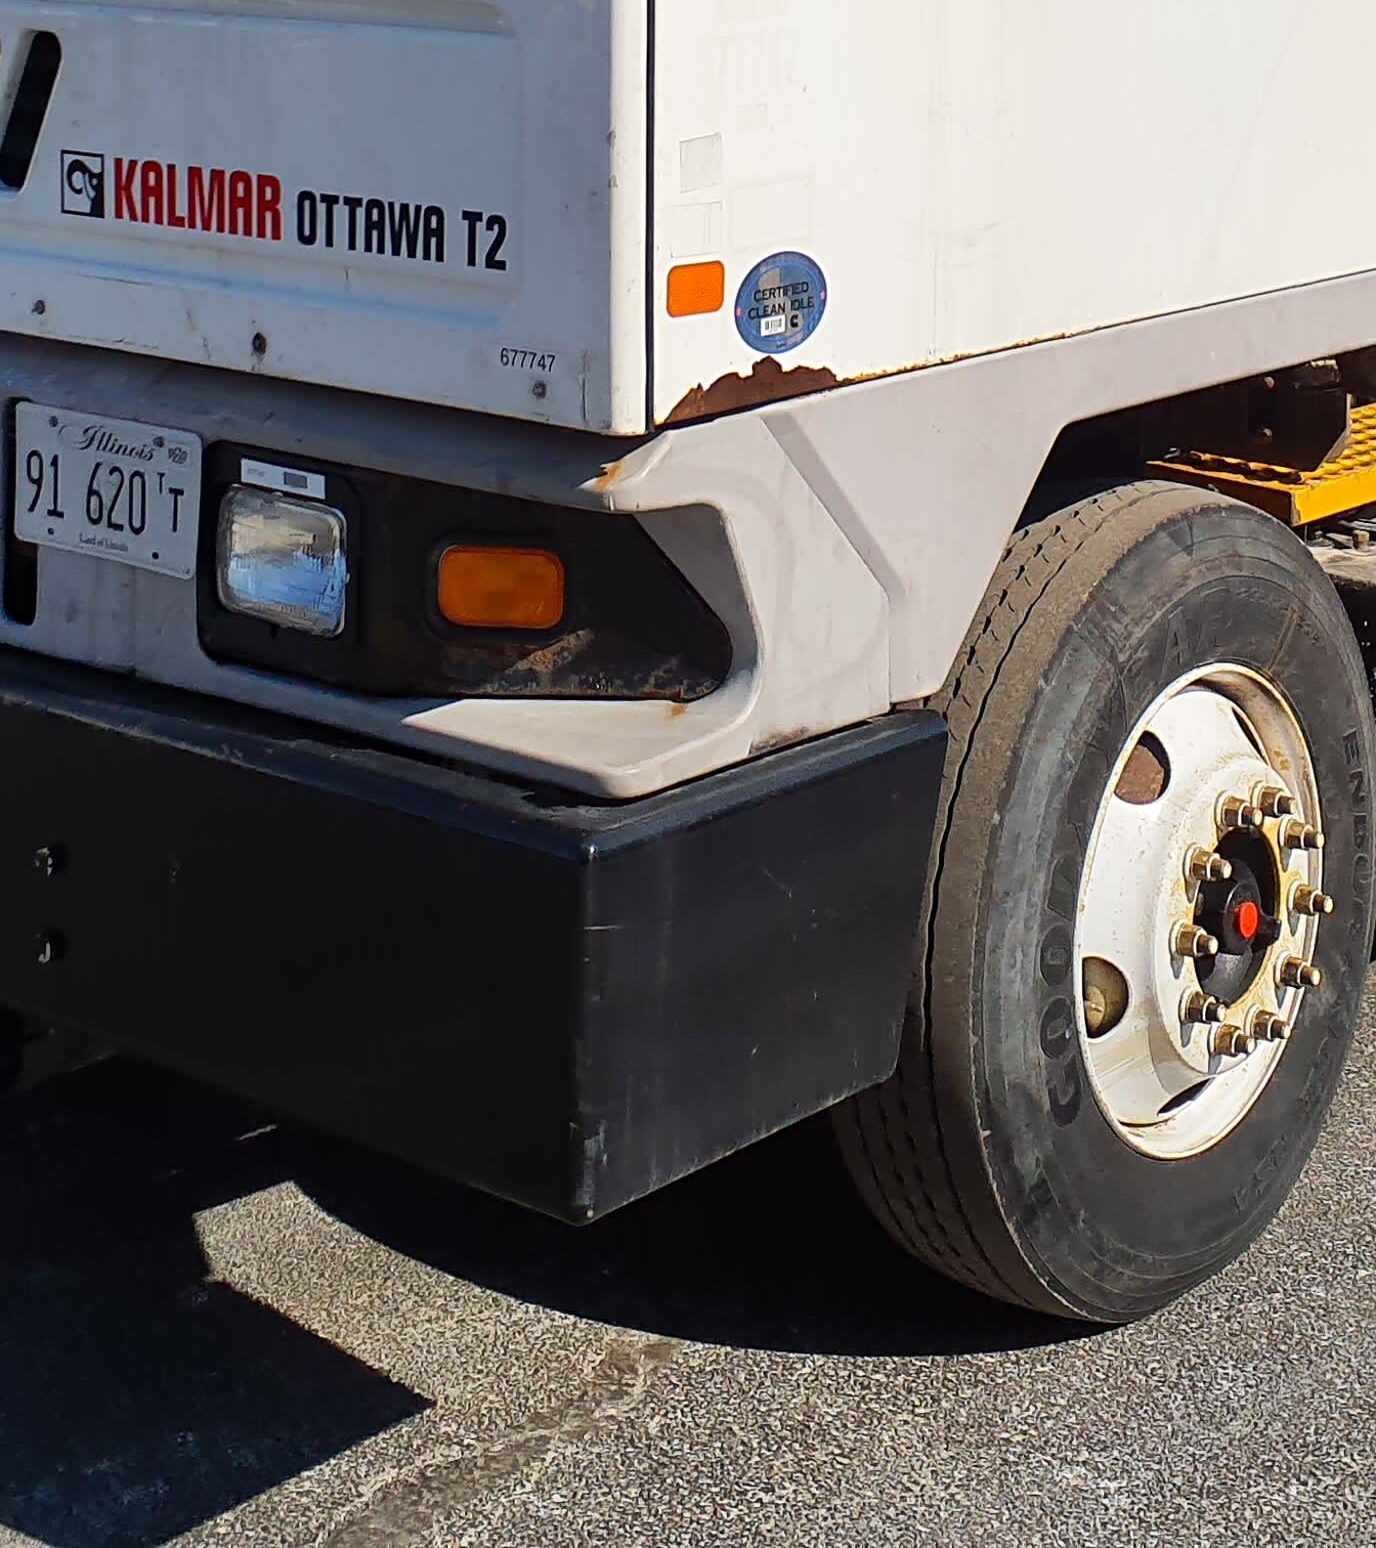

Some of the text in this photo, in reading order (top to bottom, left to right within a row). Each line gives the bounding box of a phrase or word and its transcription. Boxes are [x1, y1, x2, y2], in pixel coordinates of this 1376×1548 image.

[114, 157, 508, 271] KALMAR OTTAWA T2
[753, 281, 810, 303] CERTIFIED
[747, 296, 815, 320] CLEAN IDLE
[500, 347, 556, 373] 677747
[71, 425, 154, 461] Illinois
[26, 449, 64, 519] 91
[86, 461, 146, 536] 620
